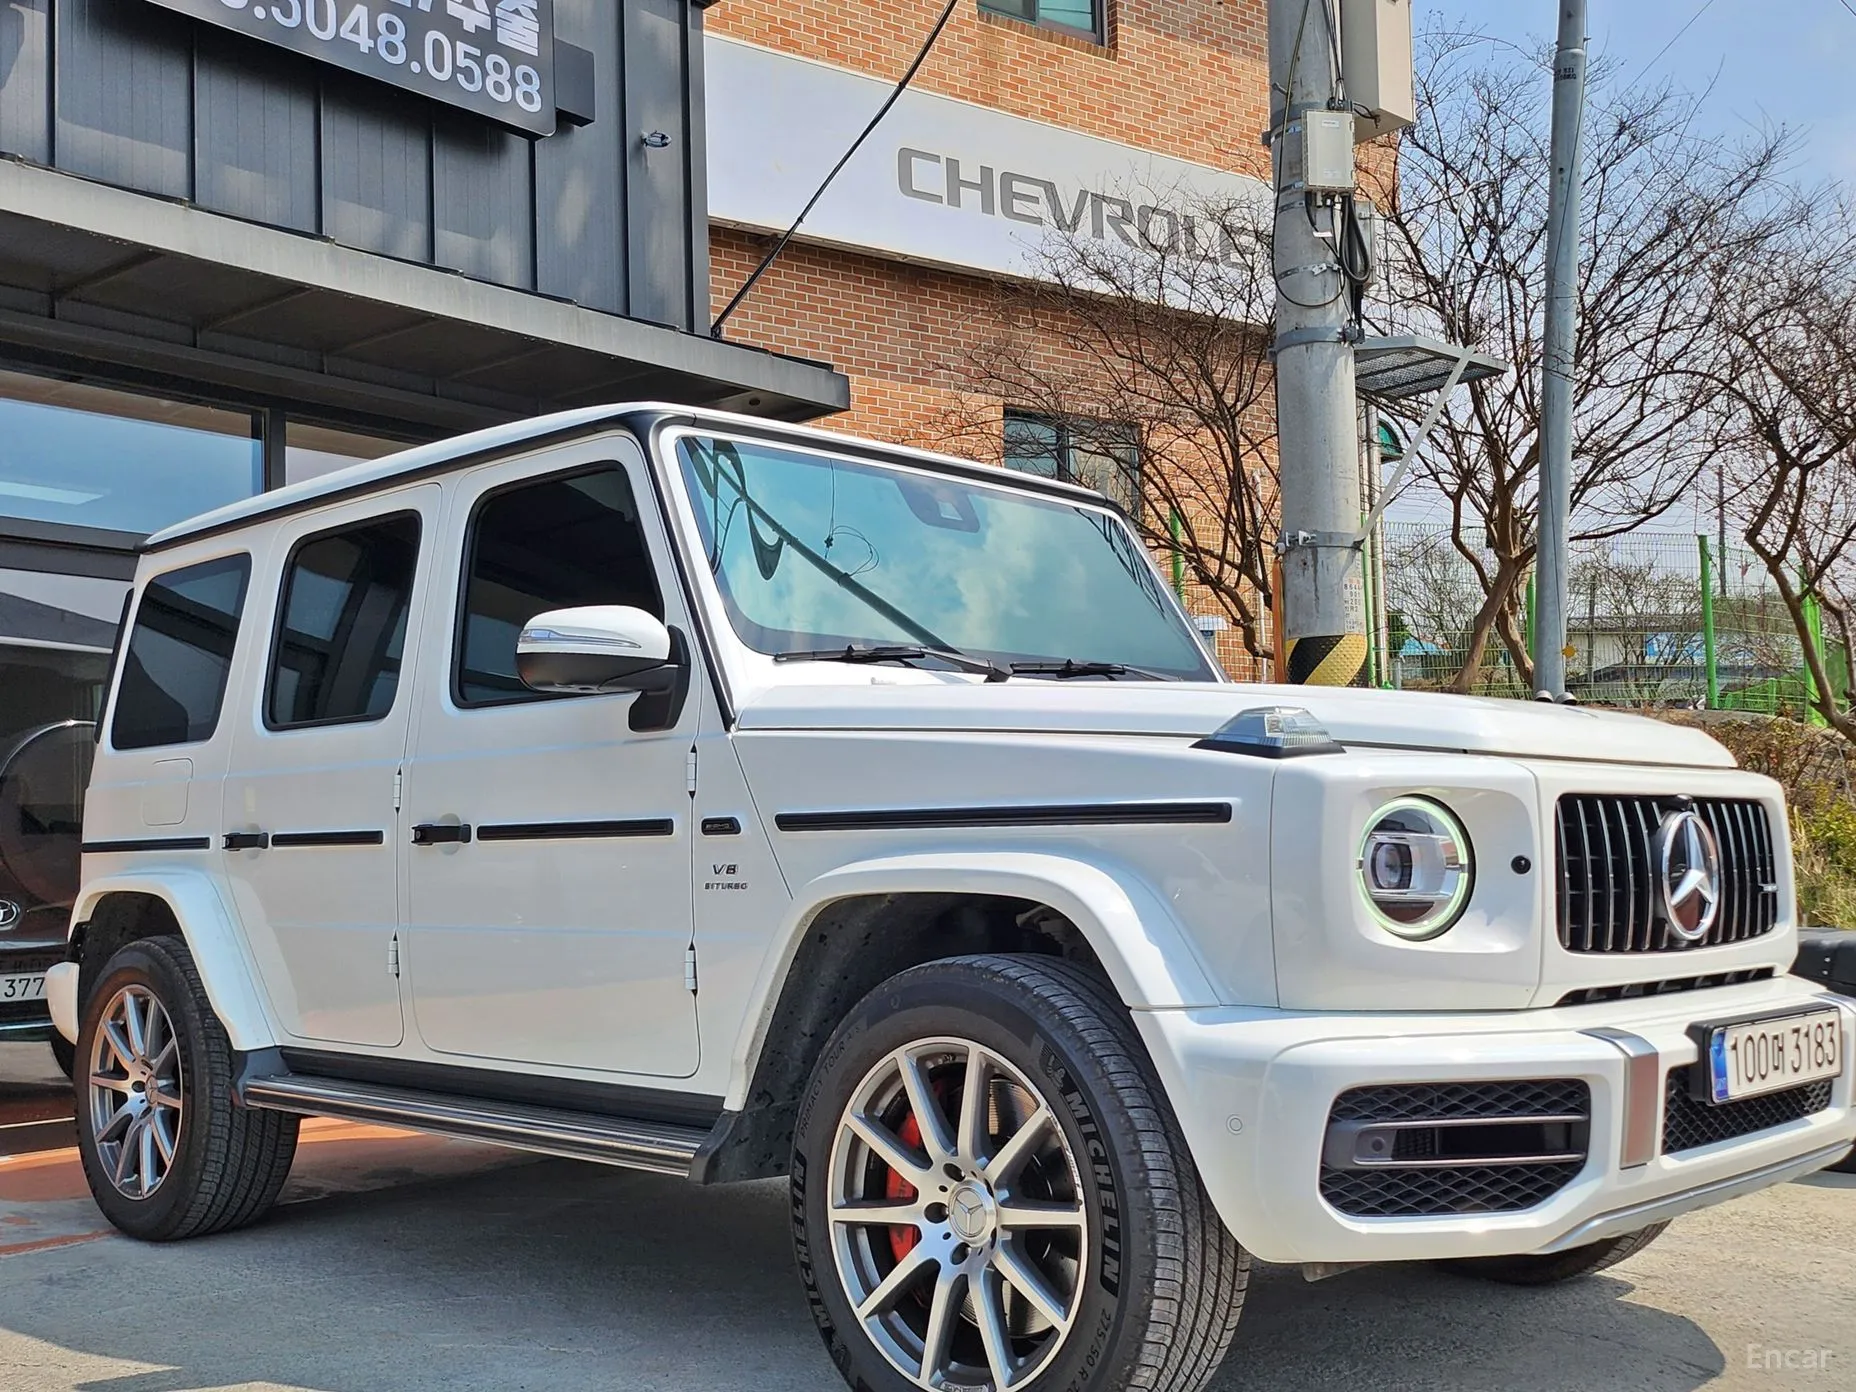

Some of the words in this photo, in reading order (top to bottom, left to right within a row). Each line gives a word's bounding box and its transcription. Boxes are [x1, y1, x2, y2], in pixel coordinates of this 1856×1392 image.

[221, 0, 542, 112] .048.0588
[898, 147, 1272, 271] CHEVROLE
[712, 864, 738, 875] V8
[800, 1079, 823, 1138] PRIMACY
[824, 1040, 845, 1075] TOUR
[1731, 1033, 1785, 1085] 100머
[1791, 1022, 1836, 1073] 3183
[1065, 1091, 1120, 1284] MICHELIN
[793, 1160, 831, 1329] MICHELIN
